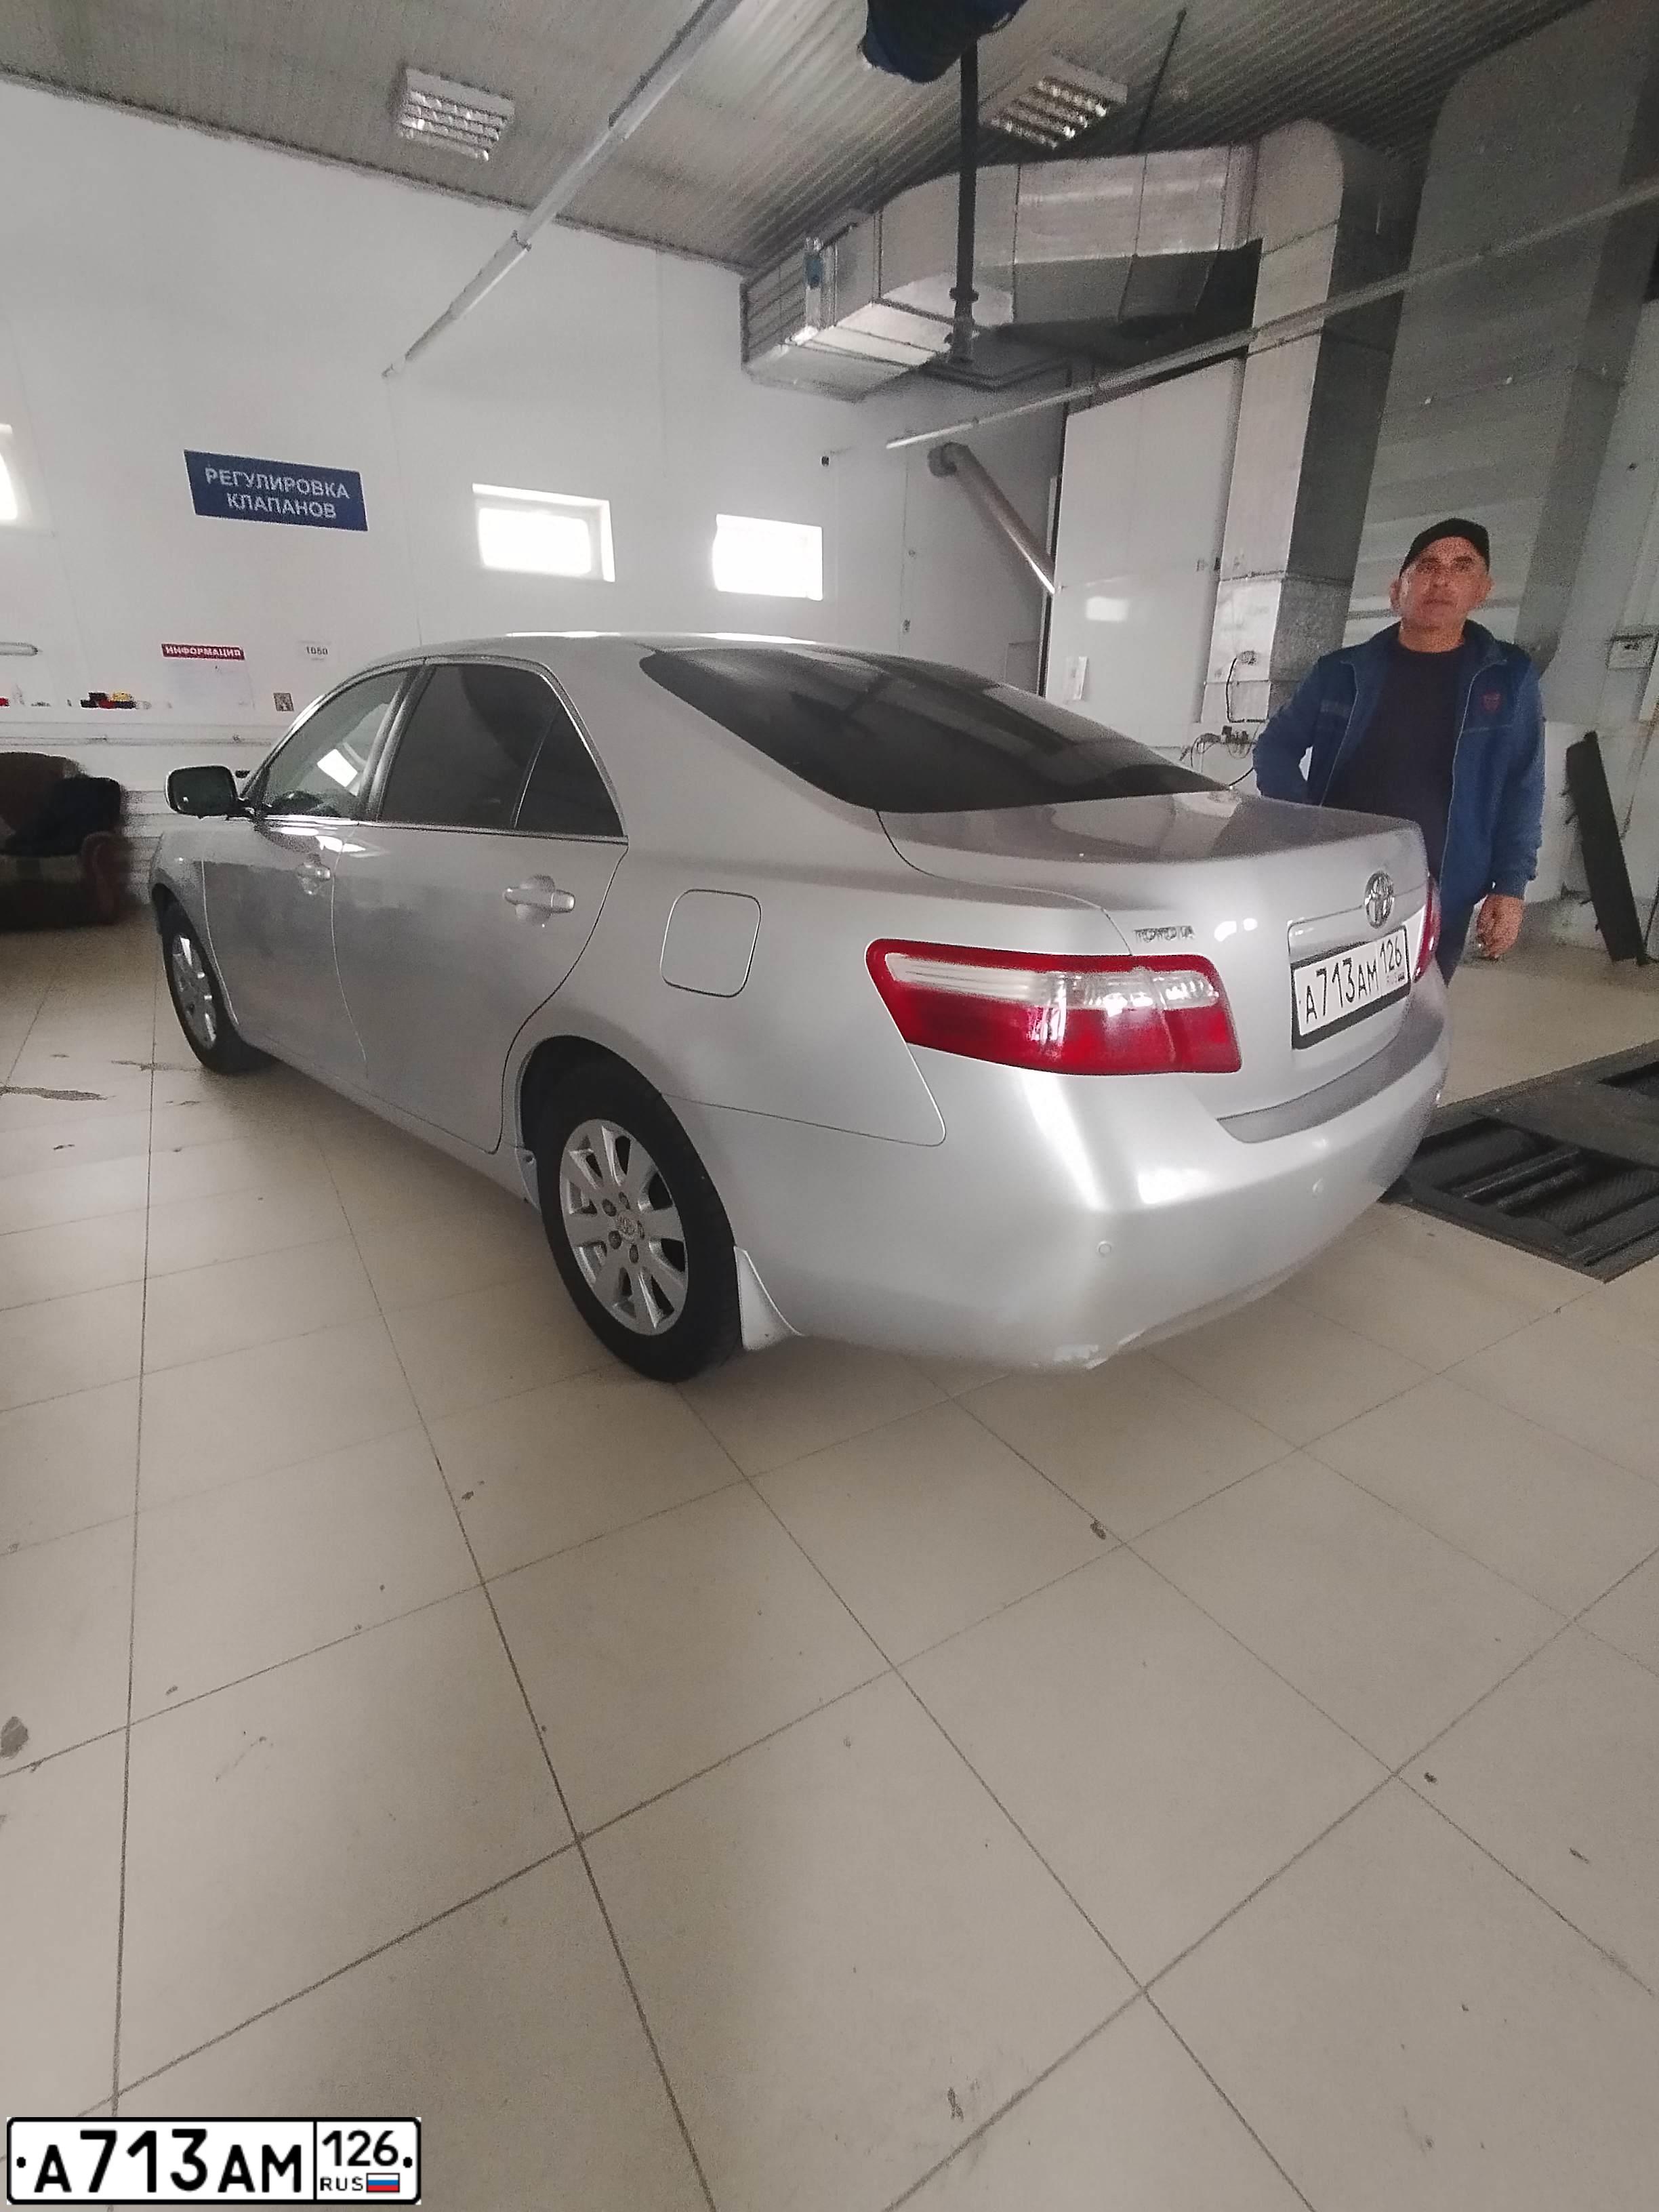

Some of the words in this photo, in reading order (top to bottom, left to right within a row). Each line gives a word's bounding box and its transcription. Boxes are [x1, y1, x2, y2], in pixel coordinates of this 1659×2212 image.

[205, 467, 350, 499] РЕГУЛИРОВКА
[226, 493, 337, 519] КЛАПАНОВ
[165, 647, 241, 658] ИНФОРМАЦИЯ
